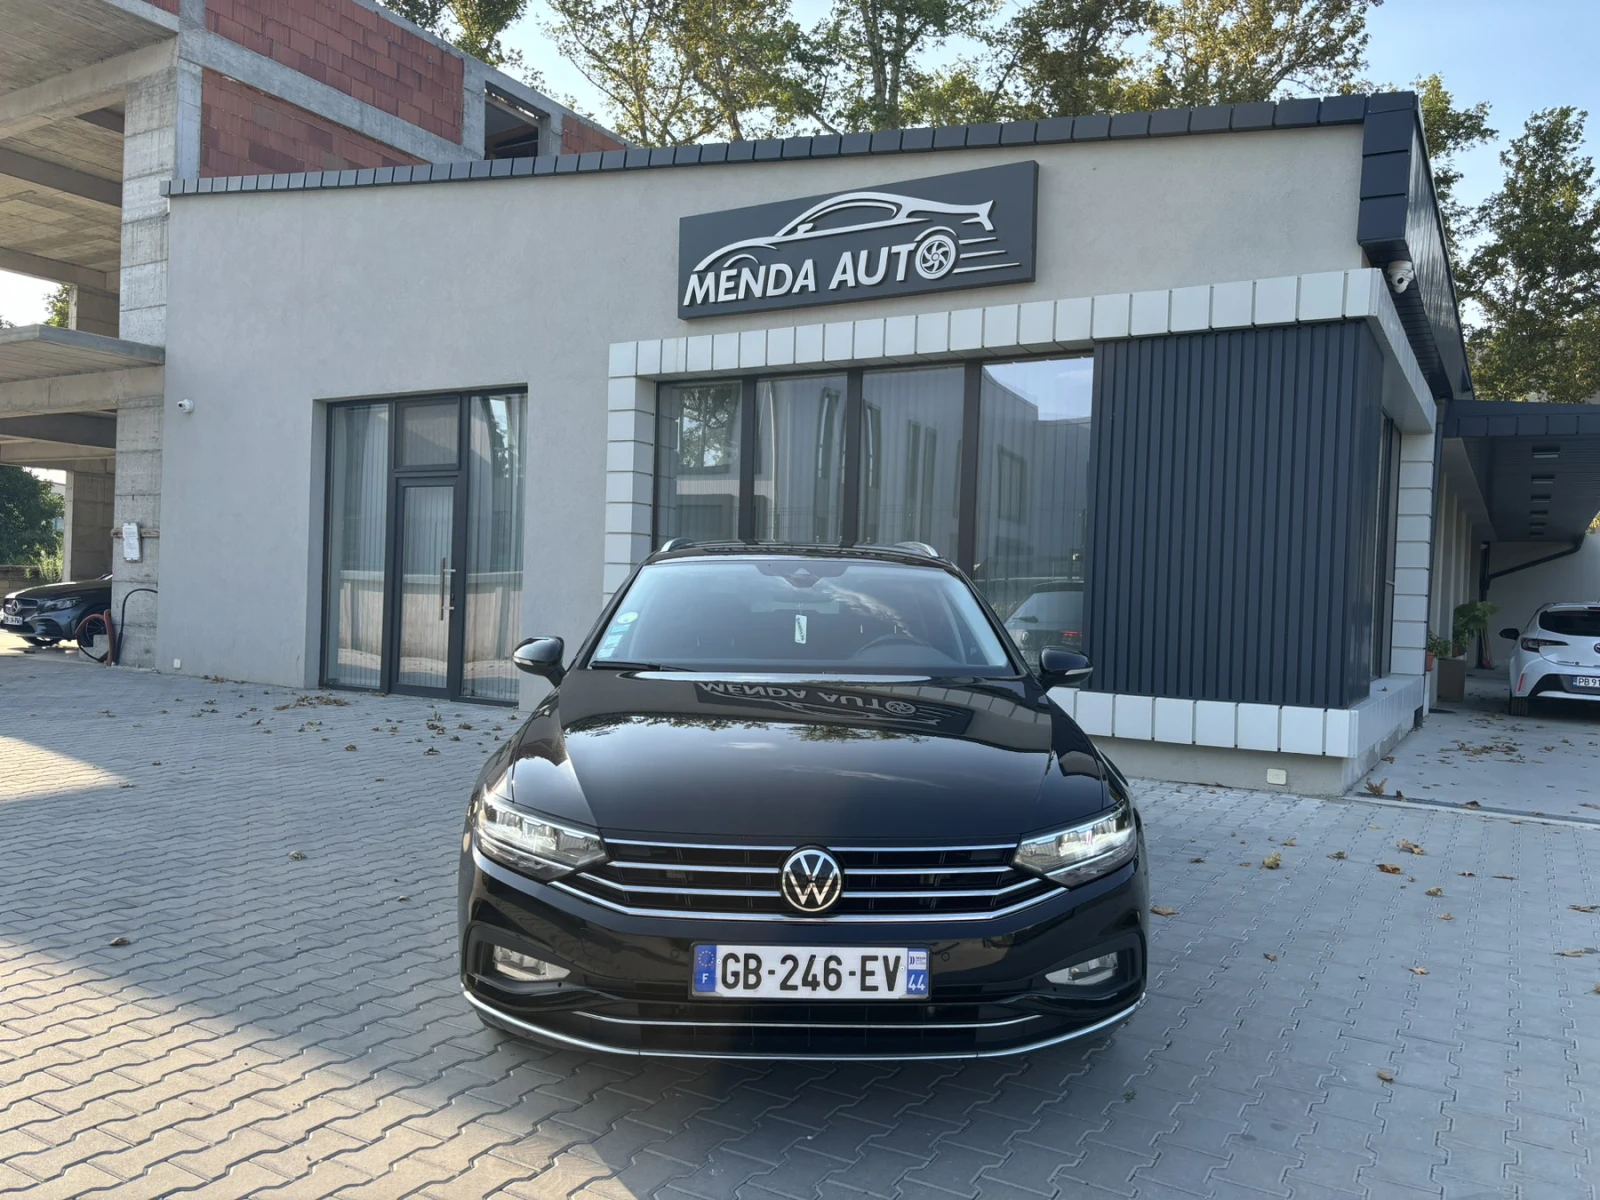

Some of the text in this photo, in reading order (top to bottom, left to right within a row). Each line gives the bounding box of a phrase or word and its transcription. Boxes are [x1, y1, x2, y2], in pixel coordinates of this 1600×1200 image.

[683, 234, 957, 306] MENDA AUTO
[1578, 677, 1590, 686] PB
[701, 973, 709, 984] F
[721, 952, 901, 992] GB-246-EV
[908, 974, 926, 991] 44
